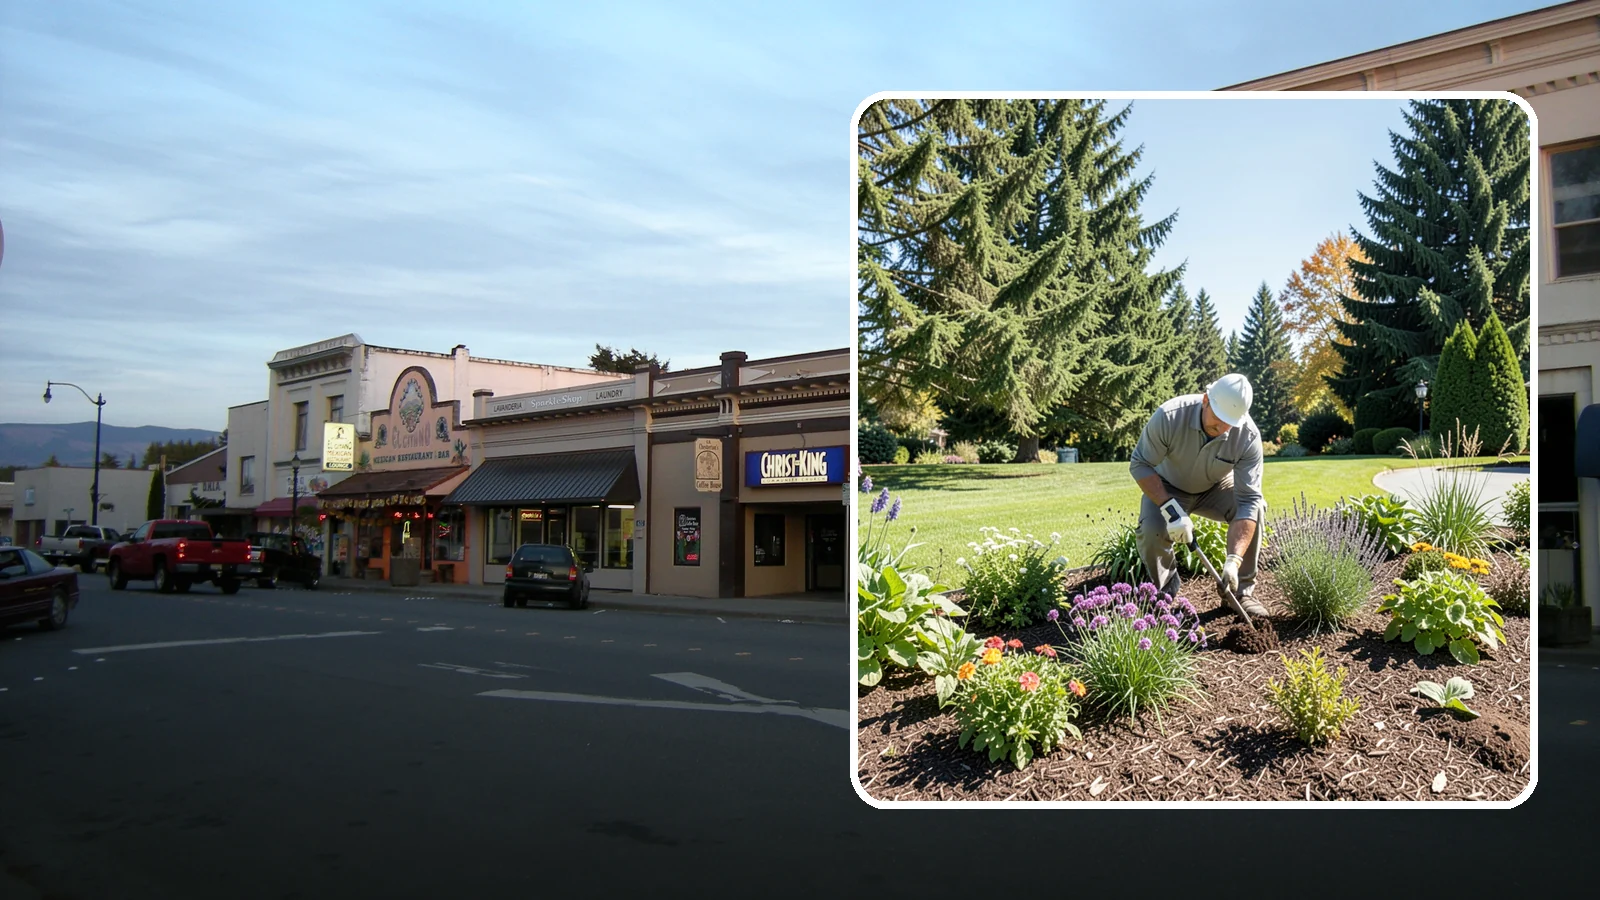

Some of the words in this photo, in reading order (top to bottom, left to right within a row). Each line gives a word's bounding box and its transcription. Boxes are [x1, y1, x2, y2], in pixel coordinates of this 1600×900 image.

[531, 397, 560, 409] Sparkle
[561, 394, 582, 405] Shop
[596, 389, 623, 400] LAUNDRY
[494, 402, 522, 413] LAVANDERIA
[374, 454, 396, 464] MEXICAN
[397, 451, 433, 462] RESTAURANT
[438, 450, 450, 459] BAR
[761, 452, 797, 478] CHRIST
[799, 450, 827, 476] KING
